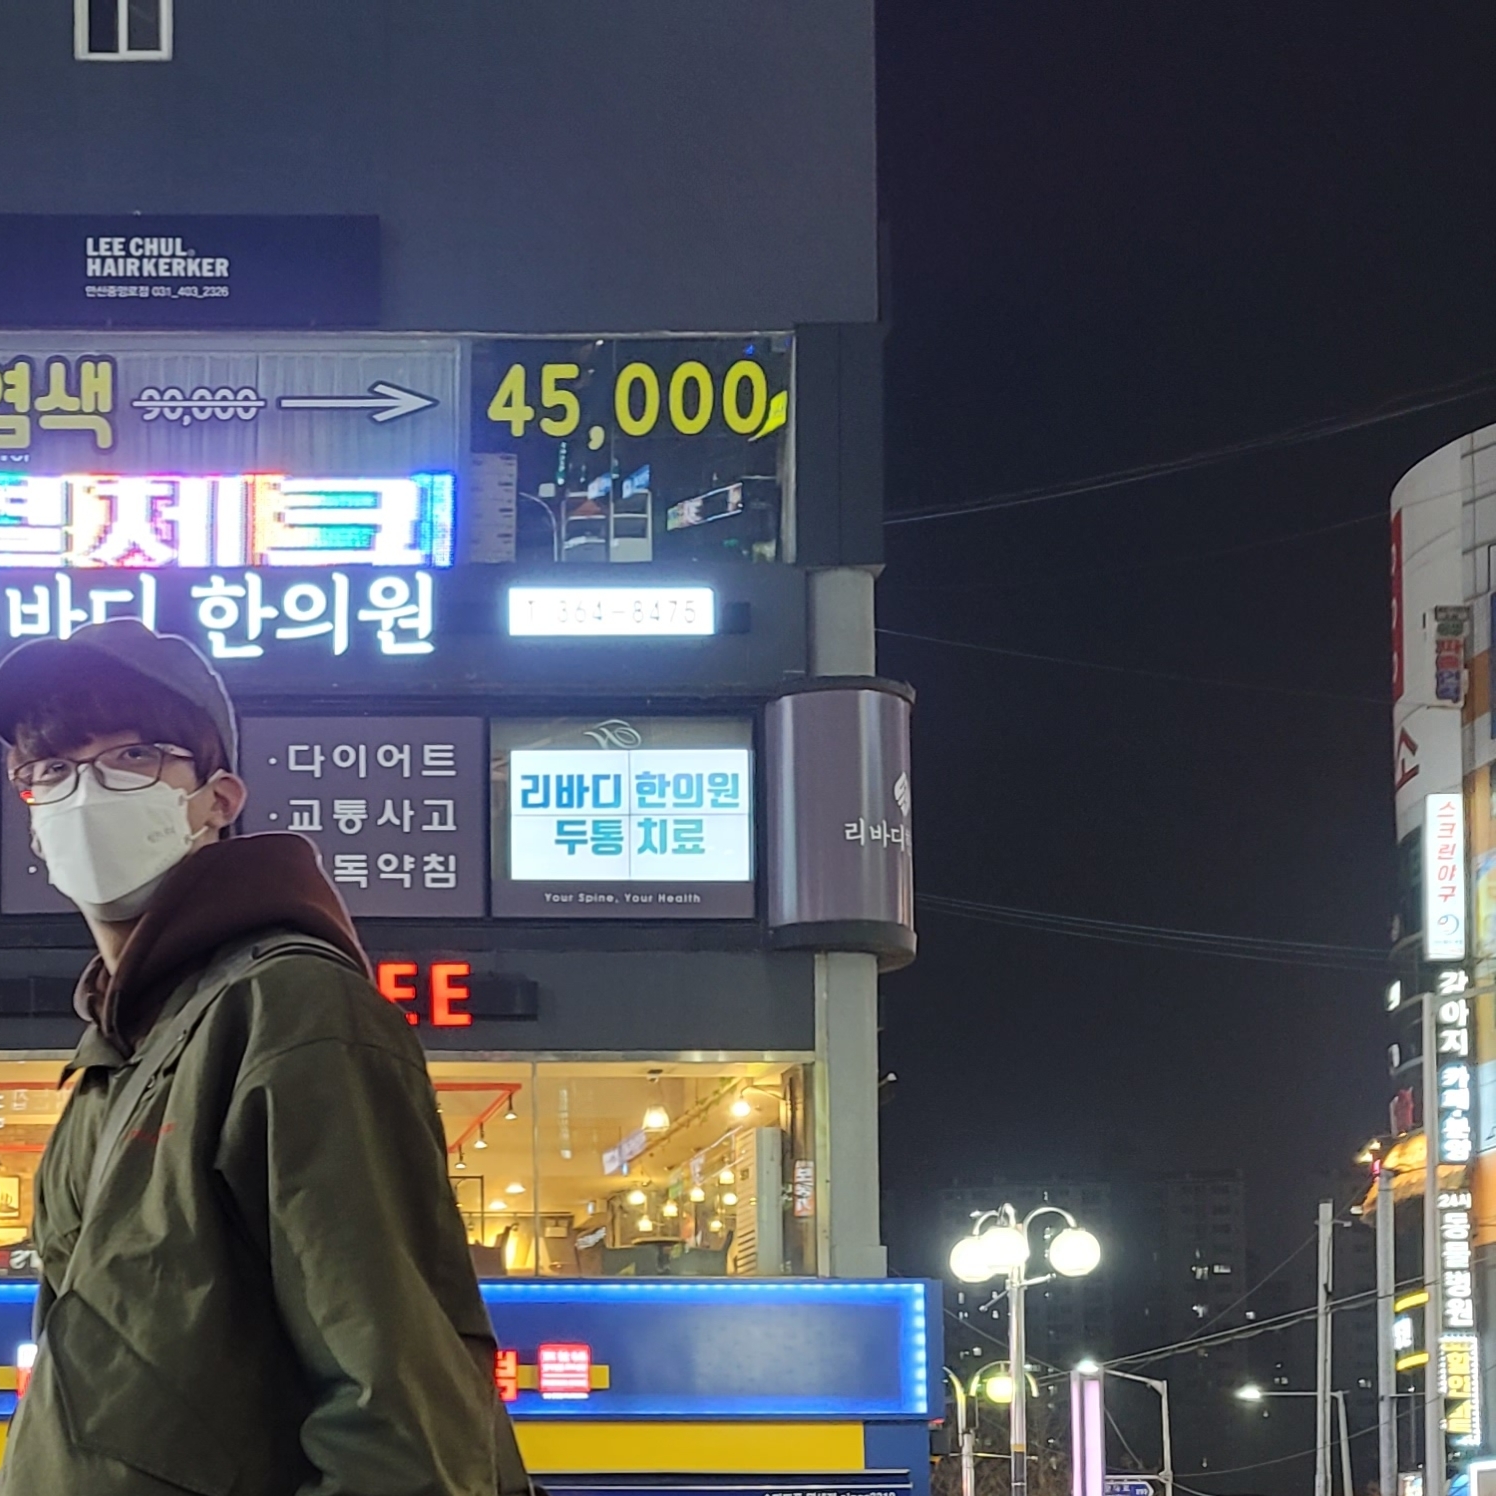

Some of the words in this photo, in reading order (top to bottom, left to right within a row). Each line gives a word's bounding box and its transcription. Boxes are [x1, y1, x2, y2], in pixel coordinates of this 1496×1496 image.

[86, 237, 126, 256] LEE
[129, 237, 188, 256] CHUL
[487, 360, 768, 451] 45,000
[191, 570, 436, 659] 한의원
[557, 599, 698, 623] 364-8475
[286, 742, 459, 779] 다이어트
[520, 771, 624, 811] 리바디
[634, 770, 741, 811] 한의원
[286, 797, 459, 834] 교통사고
[844, 816, 909, 854] 리바디
[554, 817, 625, 857] 두통
[635, 817, 707, 857] 치료
[1437, 801, 1458, 903] 스크린야구
[544, 892, 574, 905] Your
[623, 892, 654, 905] Your
[657, 892, 702, 906] Health
[1442, 1212, 1474, 1327] 동물병원
